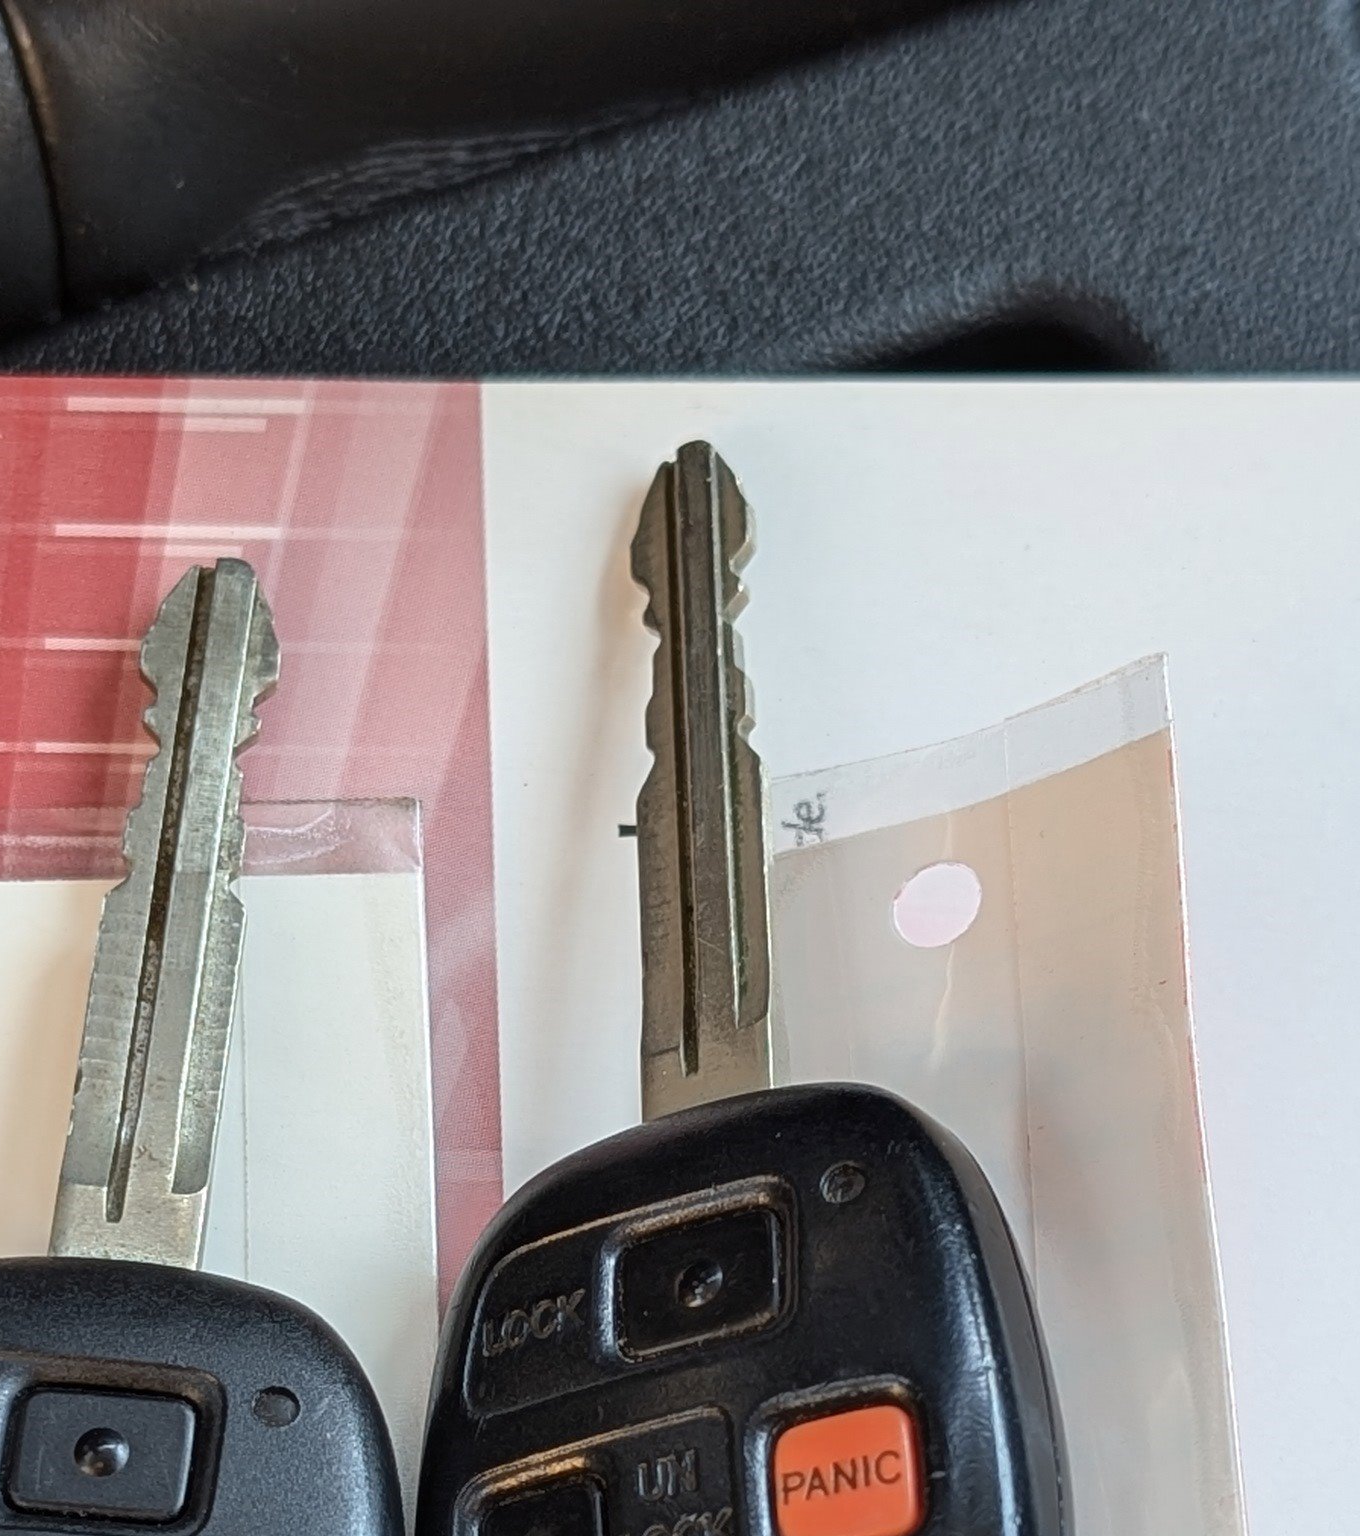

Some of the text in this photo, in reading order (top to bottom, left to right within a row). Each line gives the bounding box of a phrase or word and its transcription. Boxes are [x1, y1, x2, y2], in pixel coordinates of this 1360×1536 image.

[480, 1286, 588, 1359] LOCK
[637, 1446, 700, 1502] UN
[780, 1448, 903, 1506] PANIC
